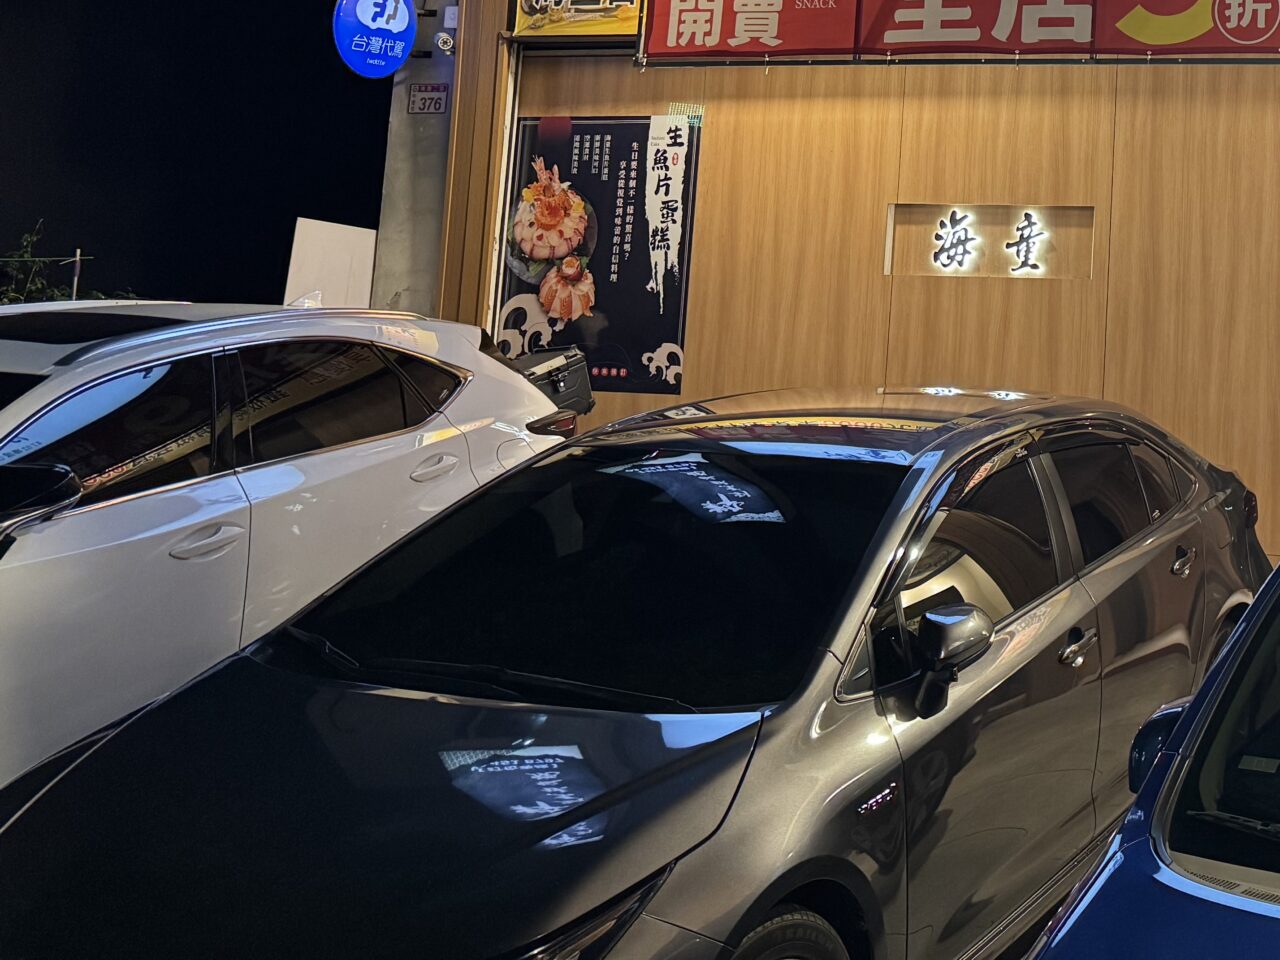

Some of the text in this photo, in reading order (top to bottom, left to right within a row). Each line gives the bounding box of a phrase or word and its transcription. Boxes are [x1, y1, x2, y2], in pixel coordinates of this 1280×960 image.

[351, 34, 405, 58] 台灣代駕
[418, 96, 442, 112] 376
[650, 124, 685, 252] 生魚片蛋糕
[933, 210, 1044, 272] 海童
